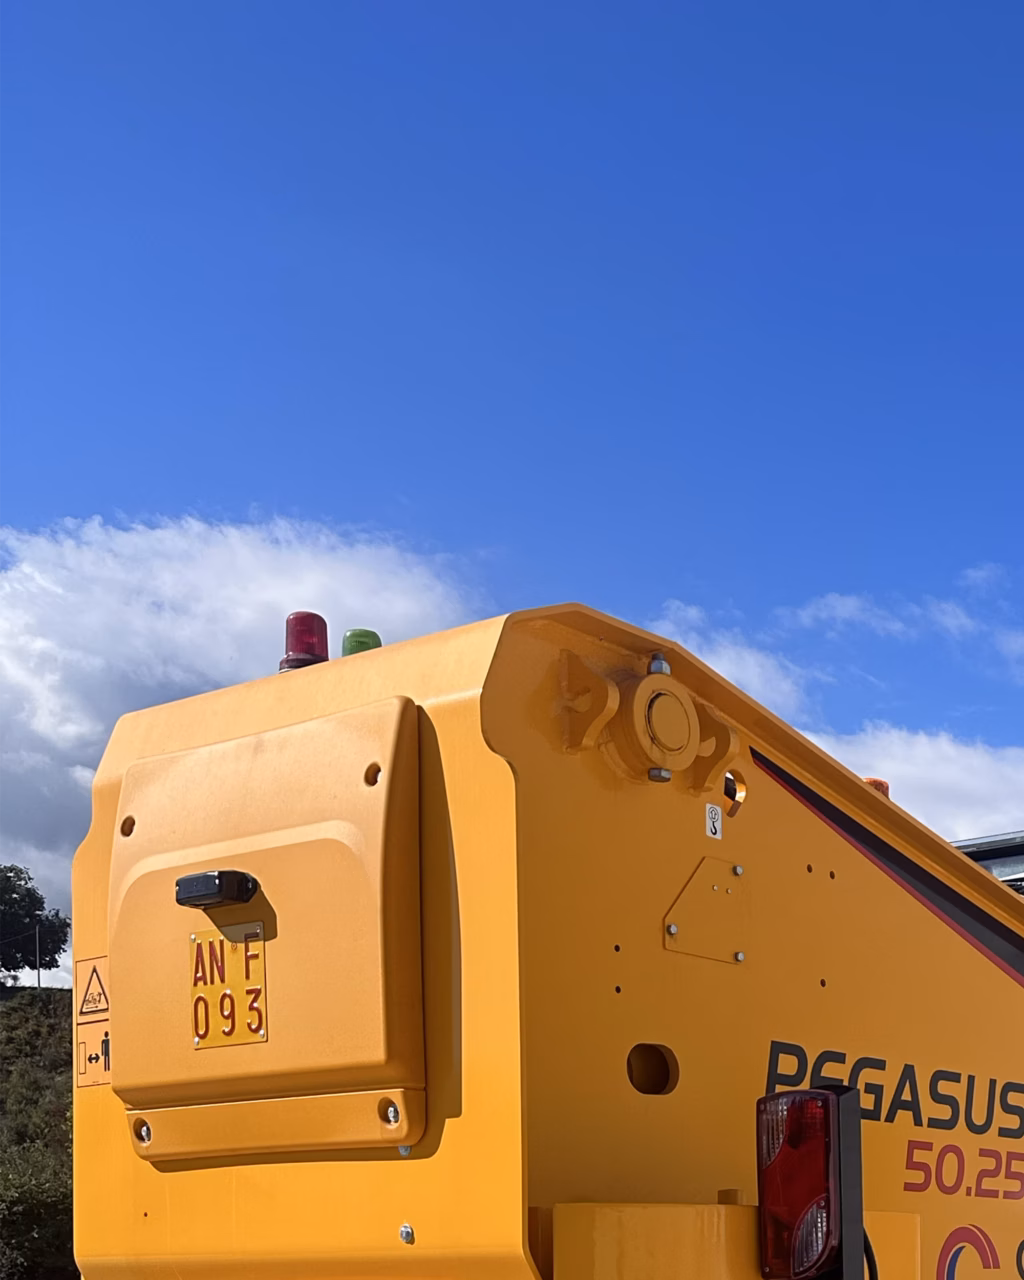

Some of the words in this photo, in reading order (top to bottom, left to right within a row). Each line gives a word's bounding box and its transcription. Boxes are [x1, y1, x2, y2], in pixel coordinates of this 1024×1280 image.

[193, 938, 226, 987] AN
[244, 932, 260, 981] F
[193, 986, 264, 1040] 093
